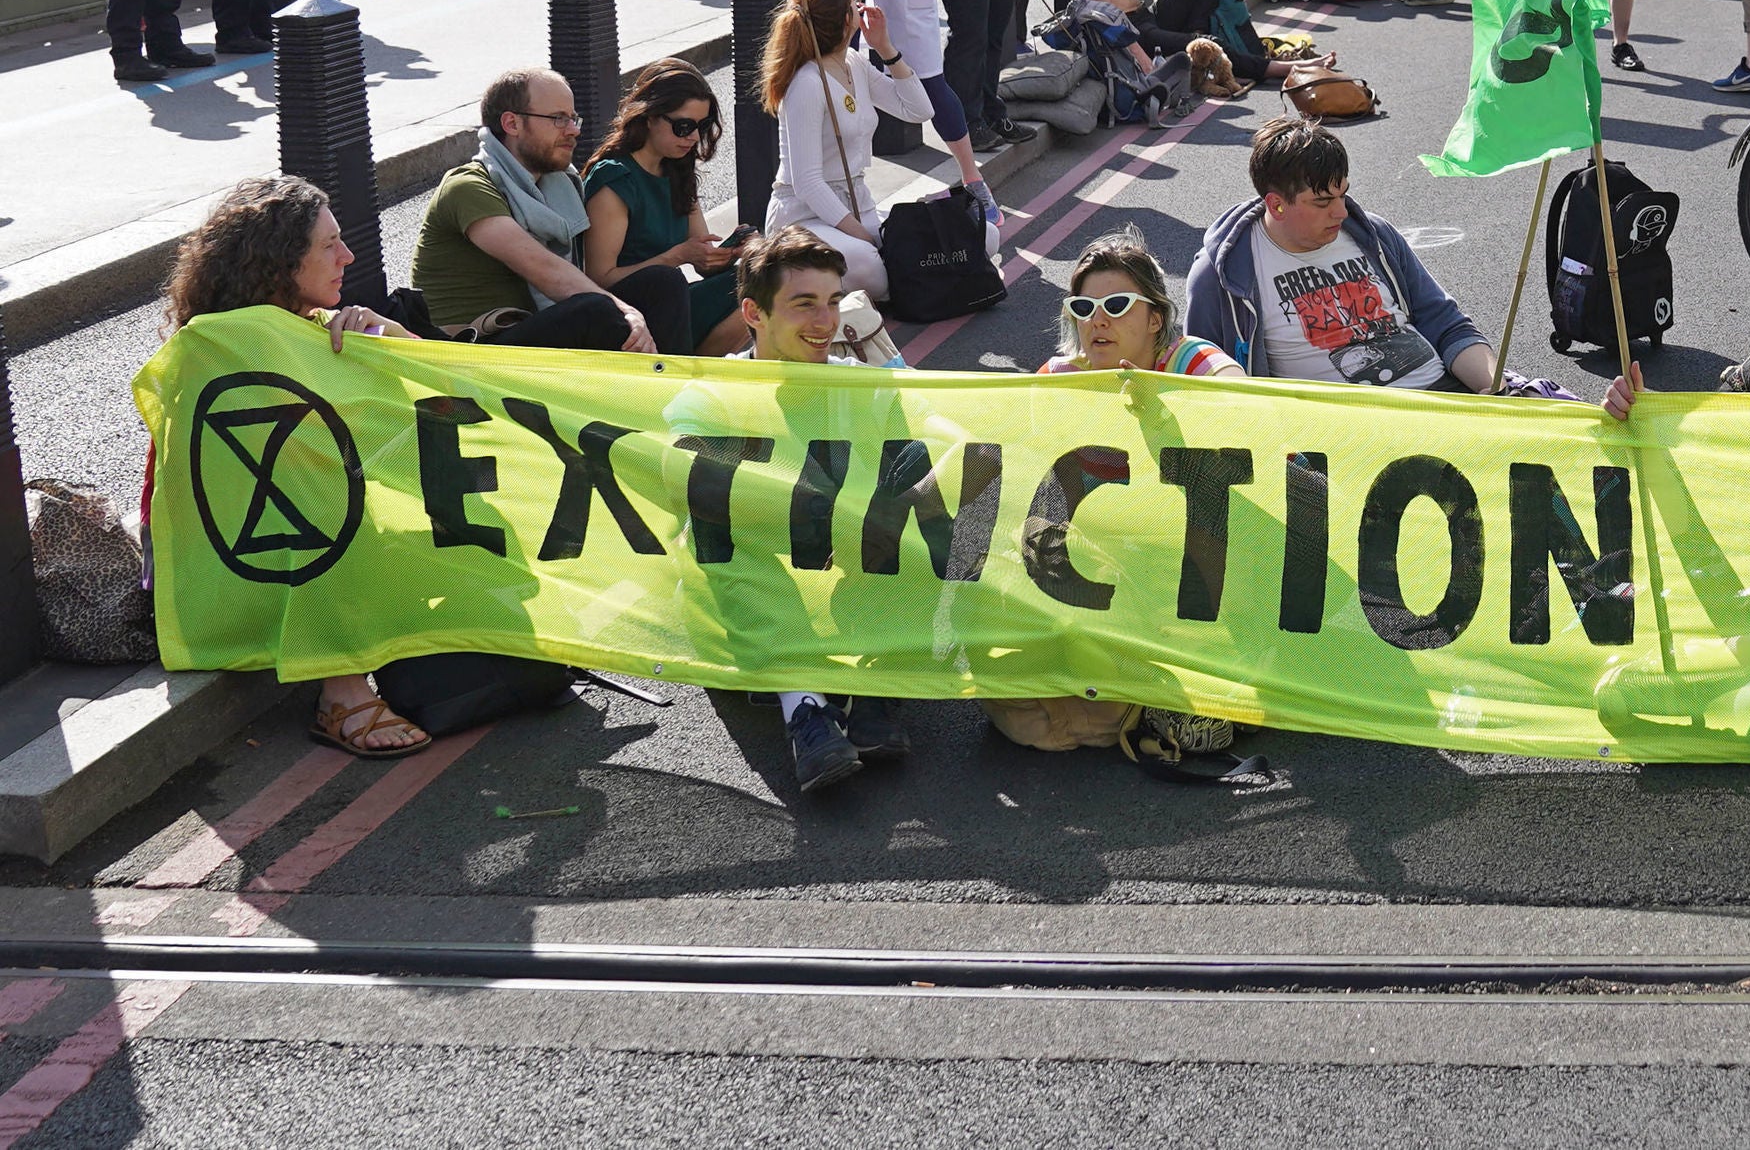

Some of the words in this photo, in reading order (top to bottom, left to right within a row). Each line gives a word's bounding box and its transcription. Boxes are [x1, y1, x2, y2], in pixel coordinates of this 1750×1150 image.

[927, 249, 967, 260] PRIOSE
[1273, 266, 1337, 302] GREEN
[1332, 256, 1371, 284] DAY
[1303, 296, 1378, 339] RADIO
[415, 396, 1635, 650] EXTINCTION
